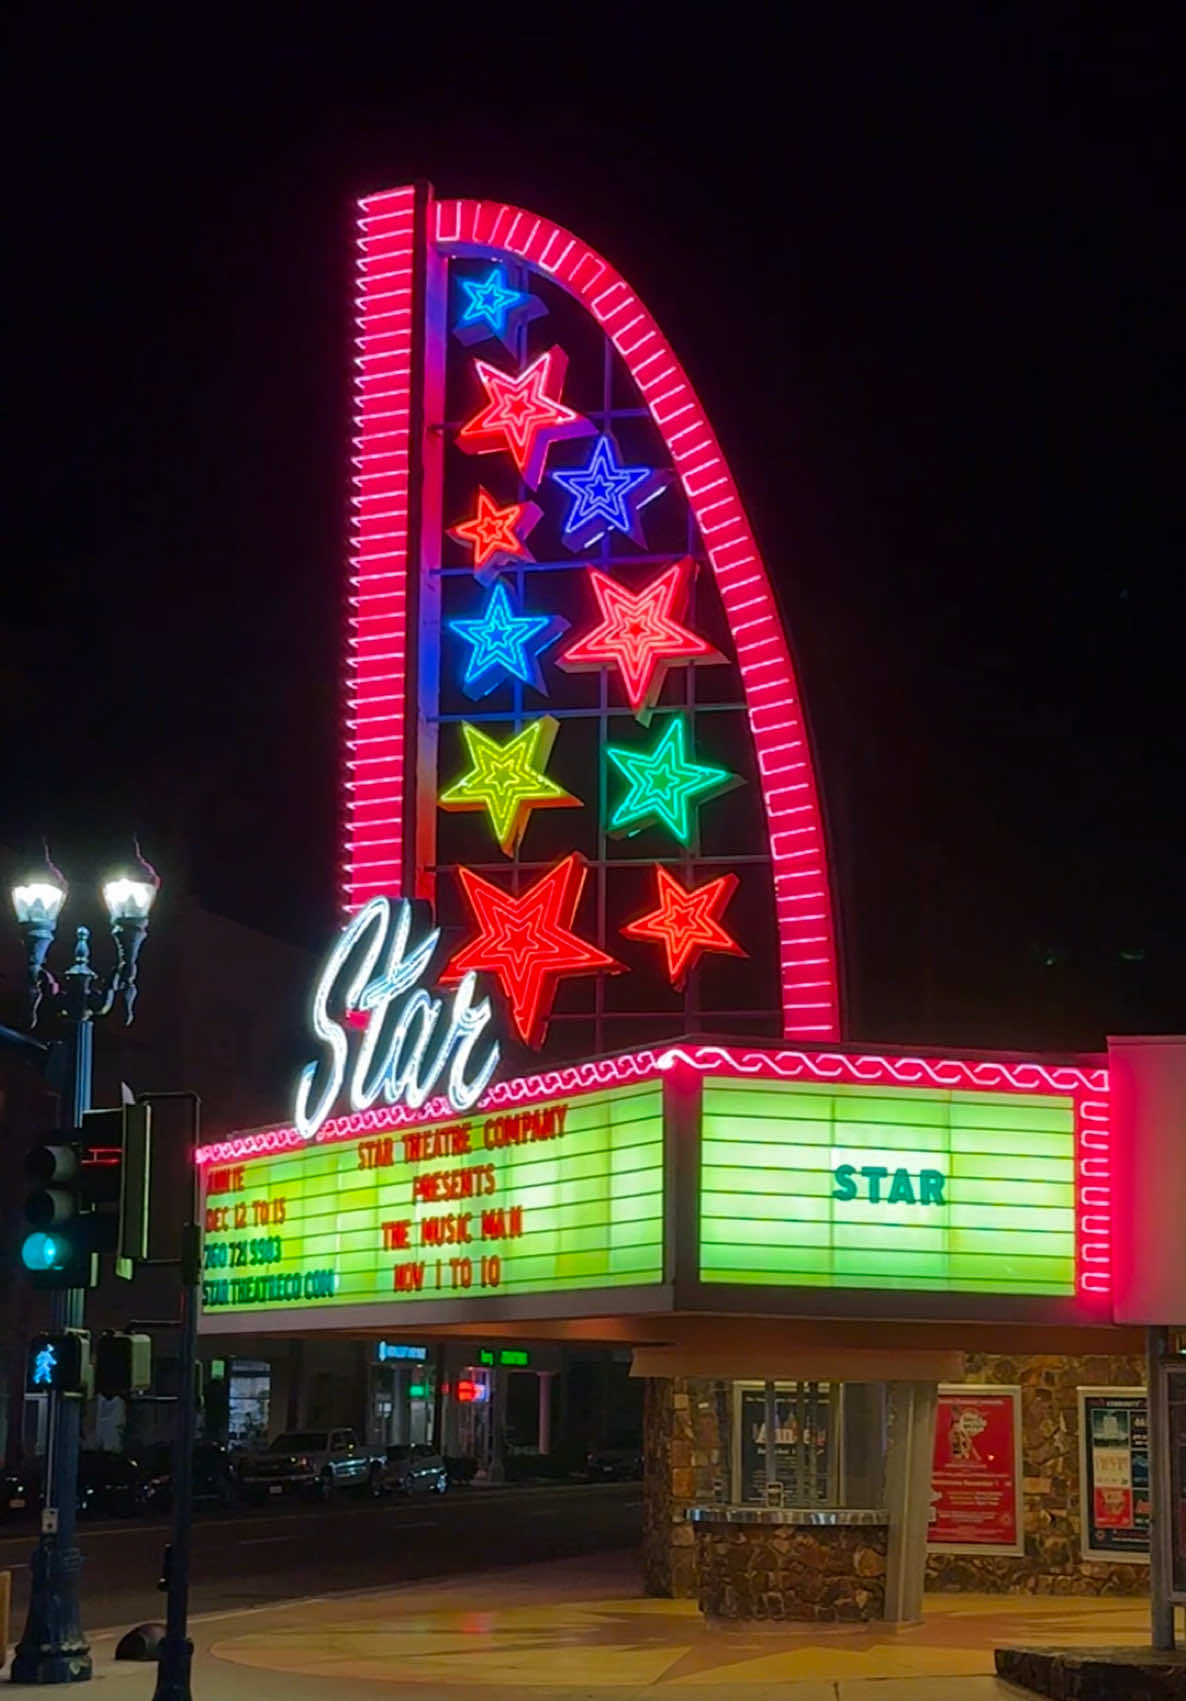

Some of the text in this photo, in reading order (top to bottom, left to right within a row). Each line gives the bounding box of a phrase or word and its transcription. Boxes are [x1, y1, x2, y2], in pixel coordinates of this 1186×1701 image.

[295, 895, 500, 1139] Star
[358, 1103, 568, 1170] STAR THEATRE COMPANY
[412, 1163, 496, 1205] PRESENTS
[832, 1164, 946, 1206] STAR
[206, 1196, 286, 1233] DEC 12 TO 15
[381, 1205, 523, 1251] THE MUSIC MAN
[393, 1255, 501, 1293] NOV 1 TO 10
